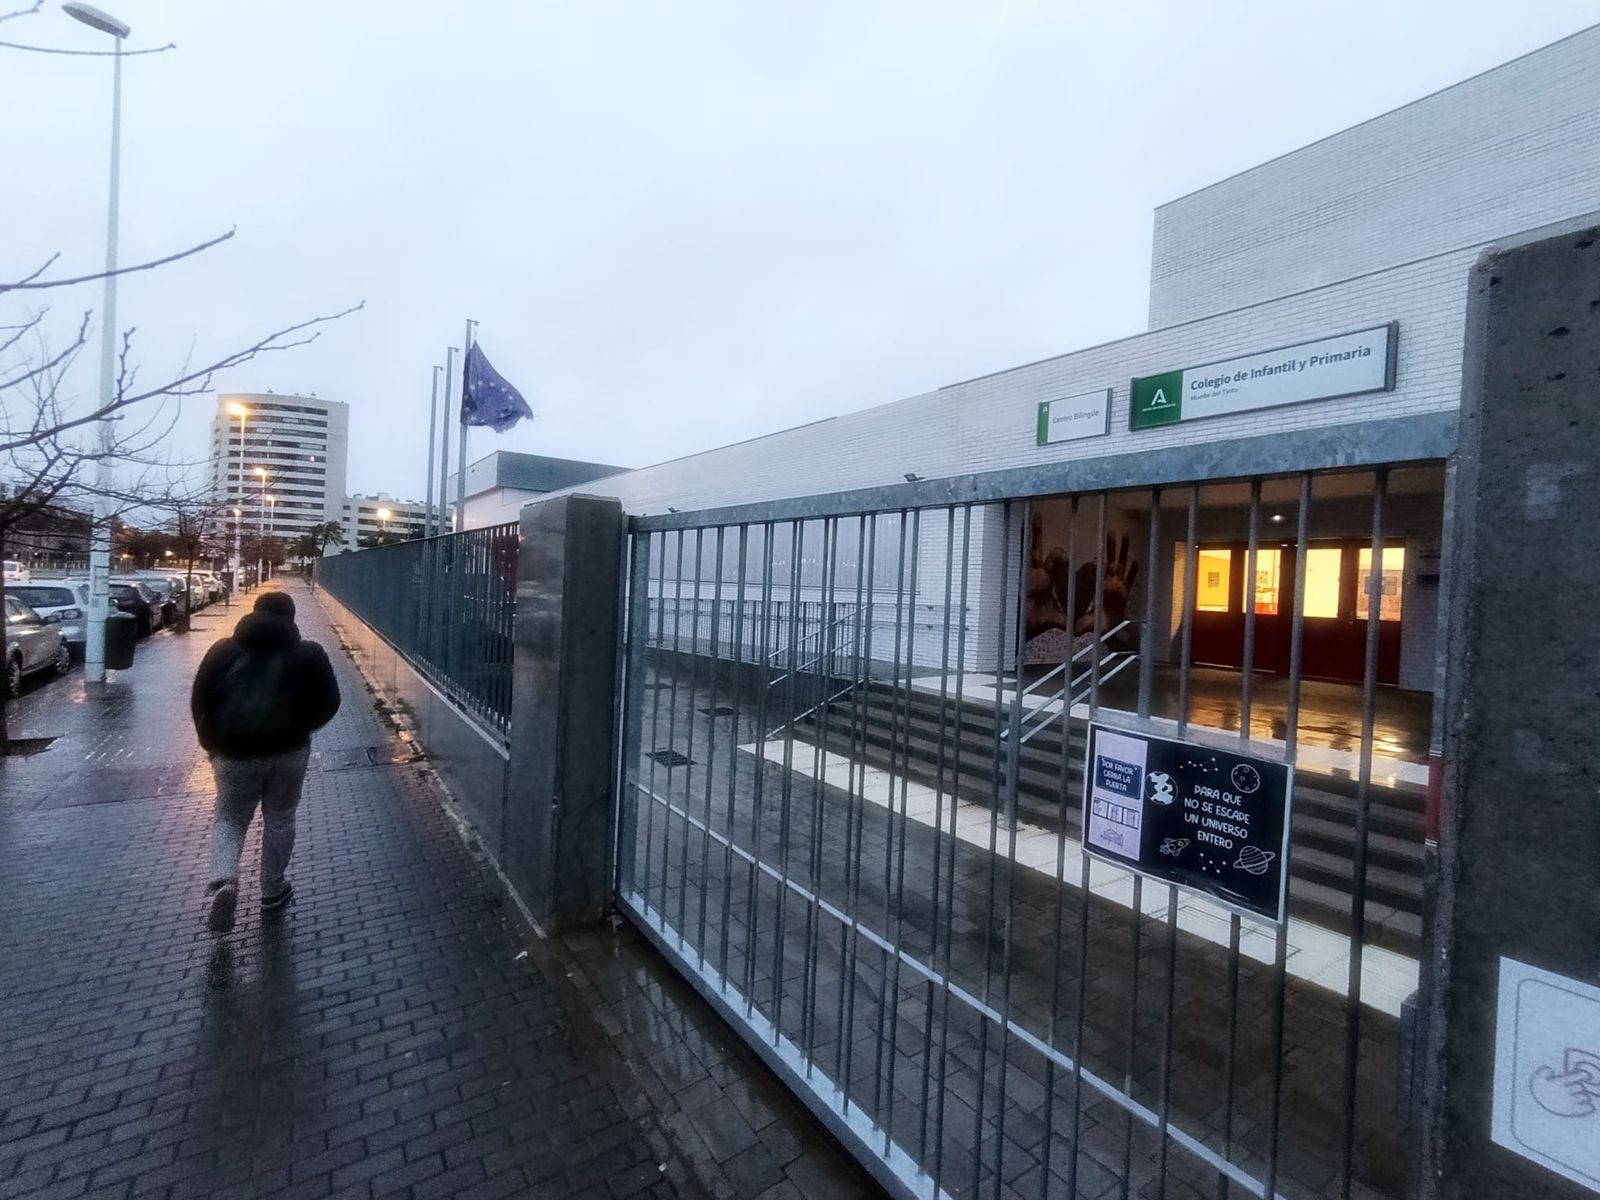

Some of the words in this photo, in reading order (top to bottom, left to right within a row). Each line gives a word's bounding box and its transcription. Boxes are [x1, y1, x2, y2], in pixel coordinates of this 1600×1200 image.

[1191, 374, 1231, 390] Colegio
[1234, 371, 1248, 382] de
[1251, 360, 1296, 379] Infantil
[1298, 359, 1306, 372] y
[1310, 346, 1371, 367] Primaria
[1053, 415, 1073, 424] Centro
[1102, 761, 1114, 770] POR
[1114, 763, 1134, 775] FAVOR
[1105, 779, 1127, 792] PUERTA
[1122, 775, 1131, 784] LA
[1194, 785, 1220, 800] PARA
[1222, 792, 1242, 806] QUE
[1184, 797, 1199, 809] NO
[1201, 801, 1214, 814] SE
[1215, 805, 1250, 825] ESCAPE
[1184, 812, 1199, 824] UN
[1201, 817, 1248, 839] UNIVERSO
[1197, 830, 1233, 850] ENTERO
